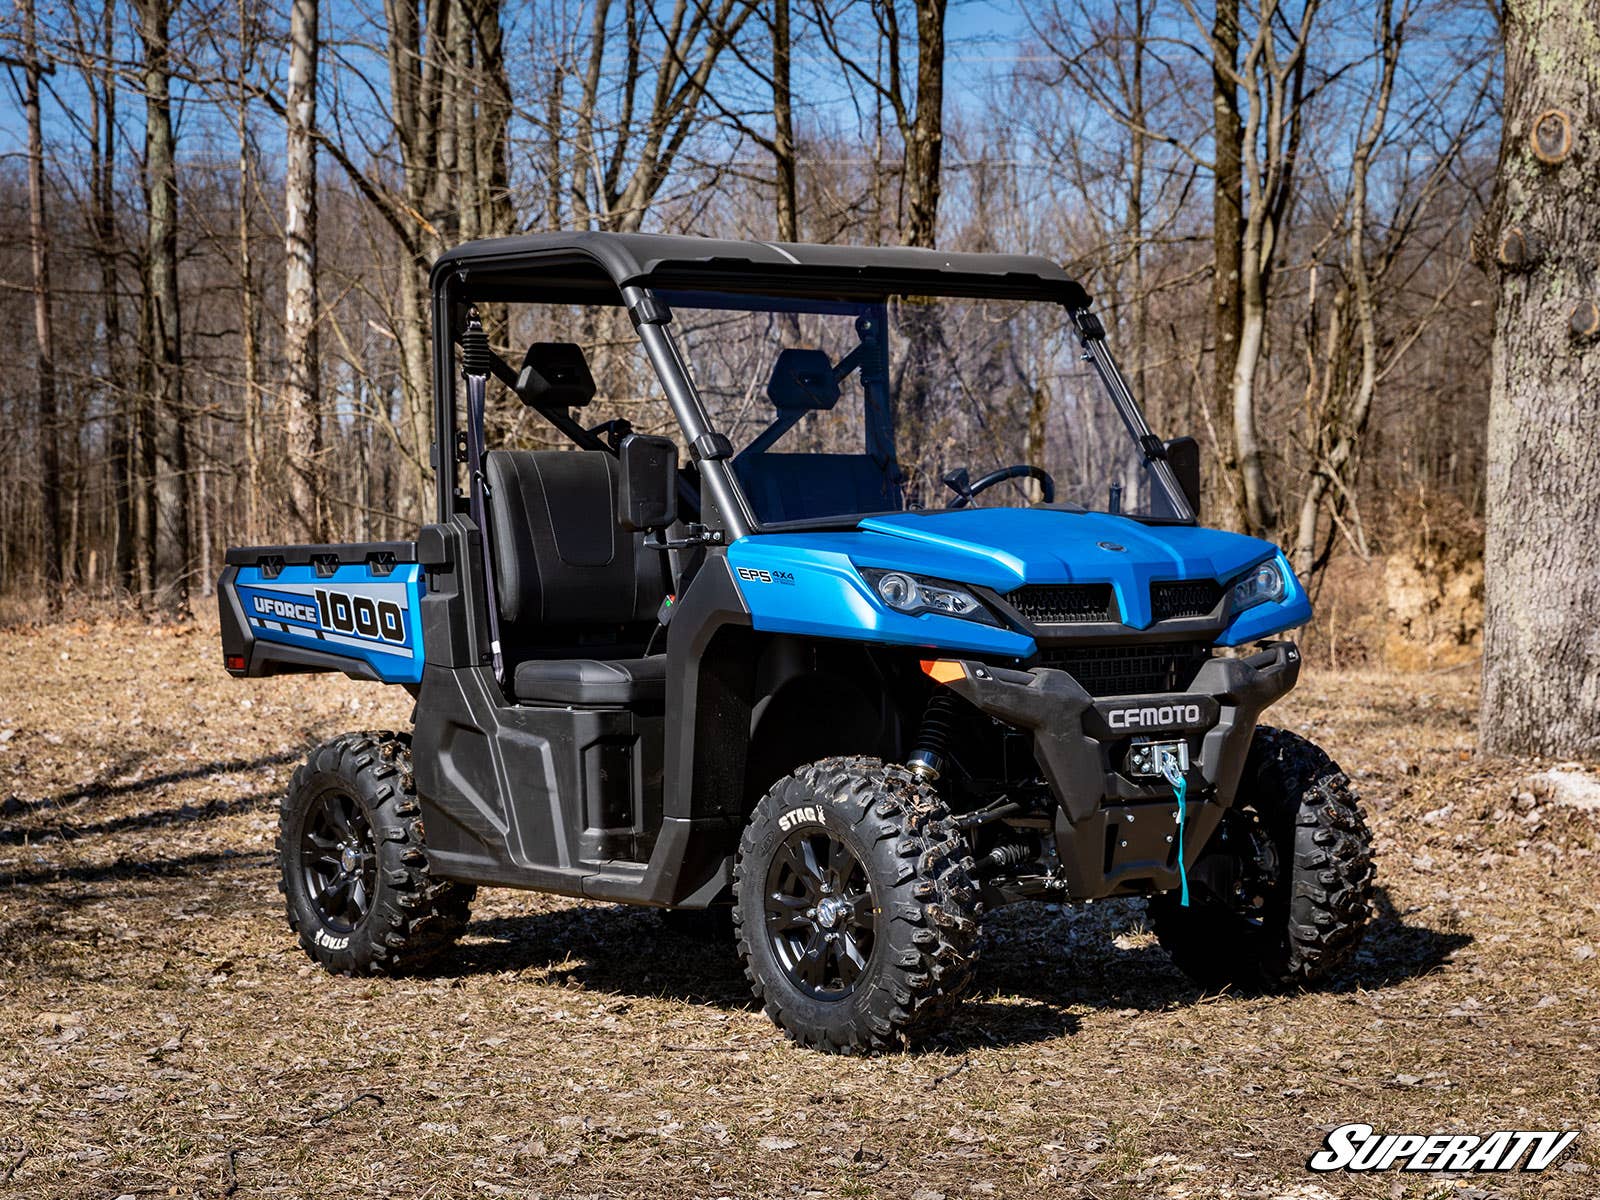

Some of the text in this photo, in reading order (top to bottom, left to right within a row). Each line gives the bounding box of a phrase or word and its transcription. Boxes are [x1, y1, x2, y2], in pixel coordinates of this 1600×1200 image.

[736, 567, 773, 583] EPS
[253, 588, 406, 643] UFORCE 1000
[1108, 704, 1200, 728] CFMOTO
[778, 807, 817, 831] STAG
[321, 934, 349, 949] STAG
